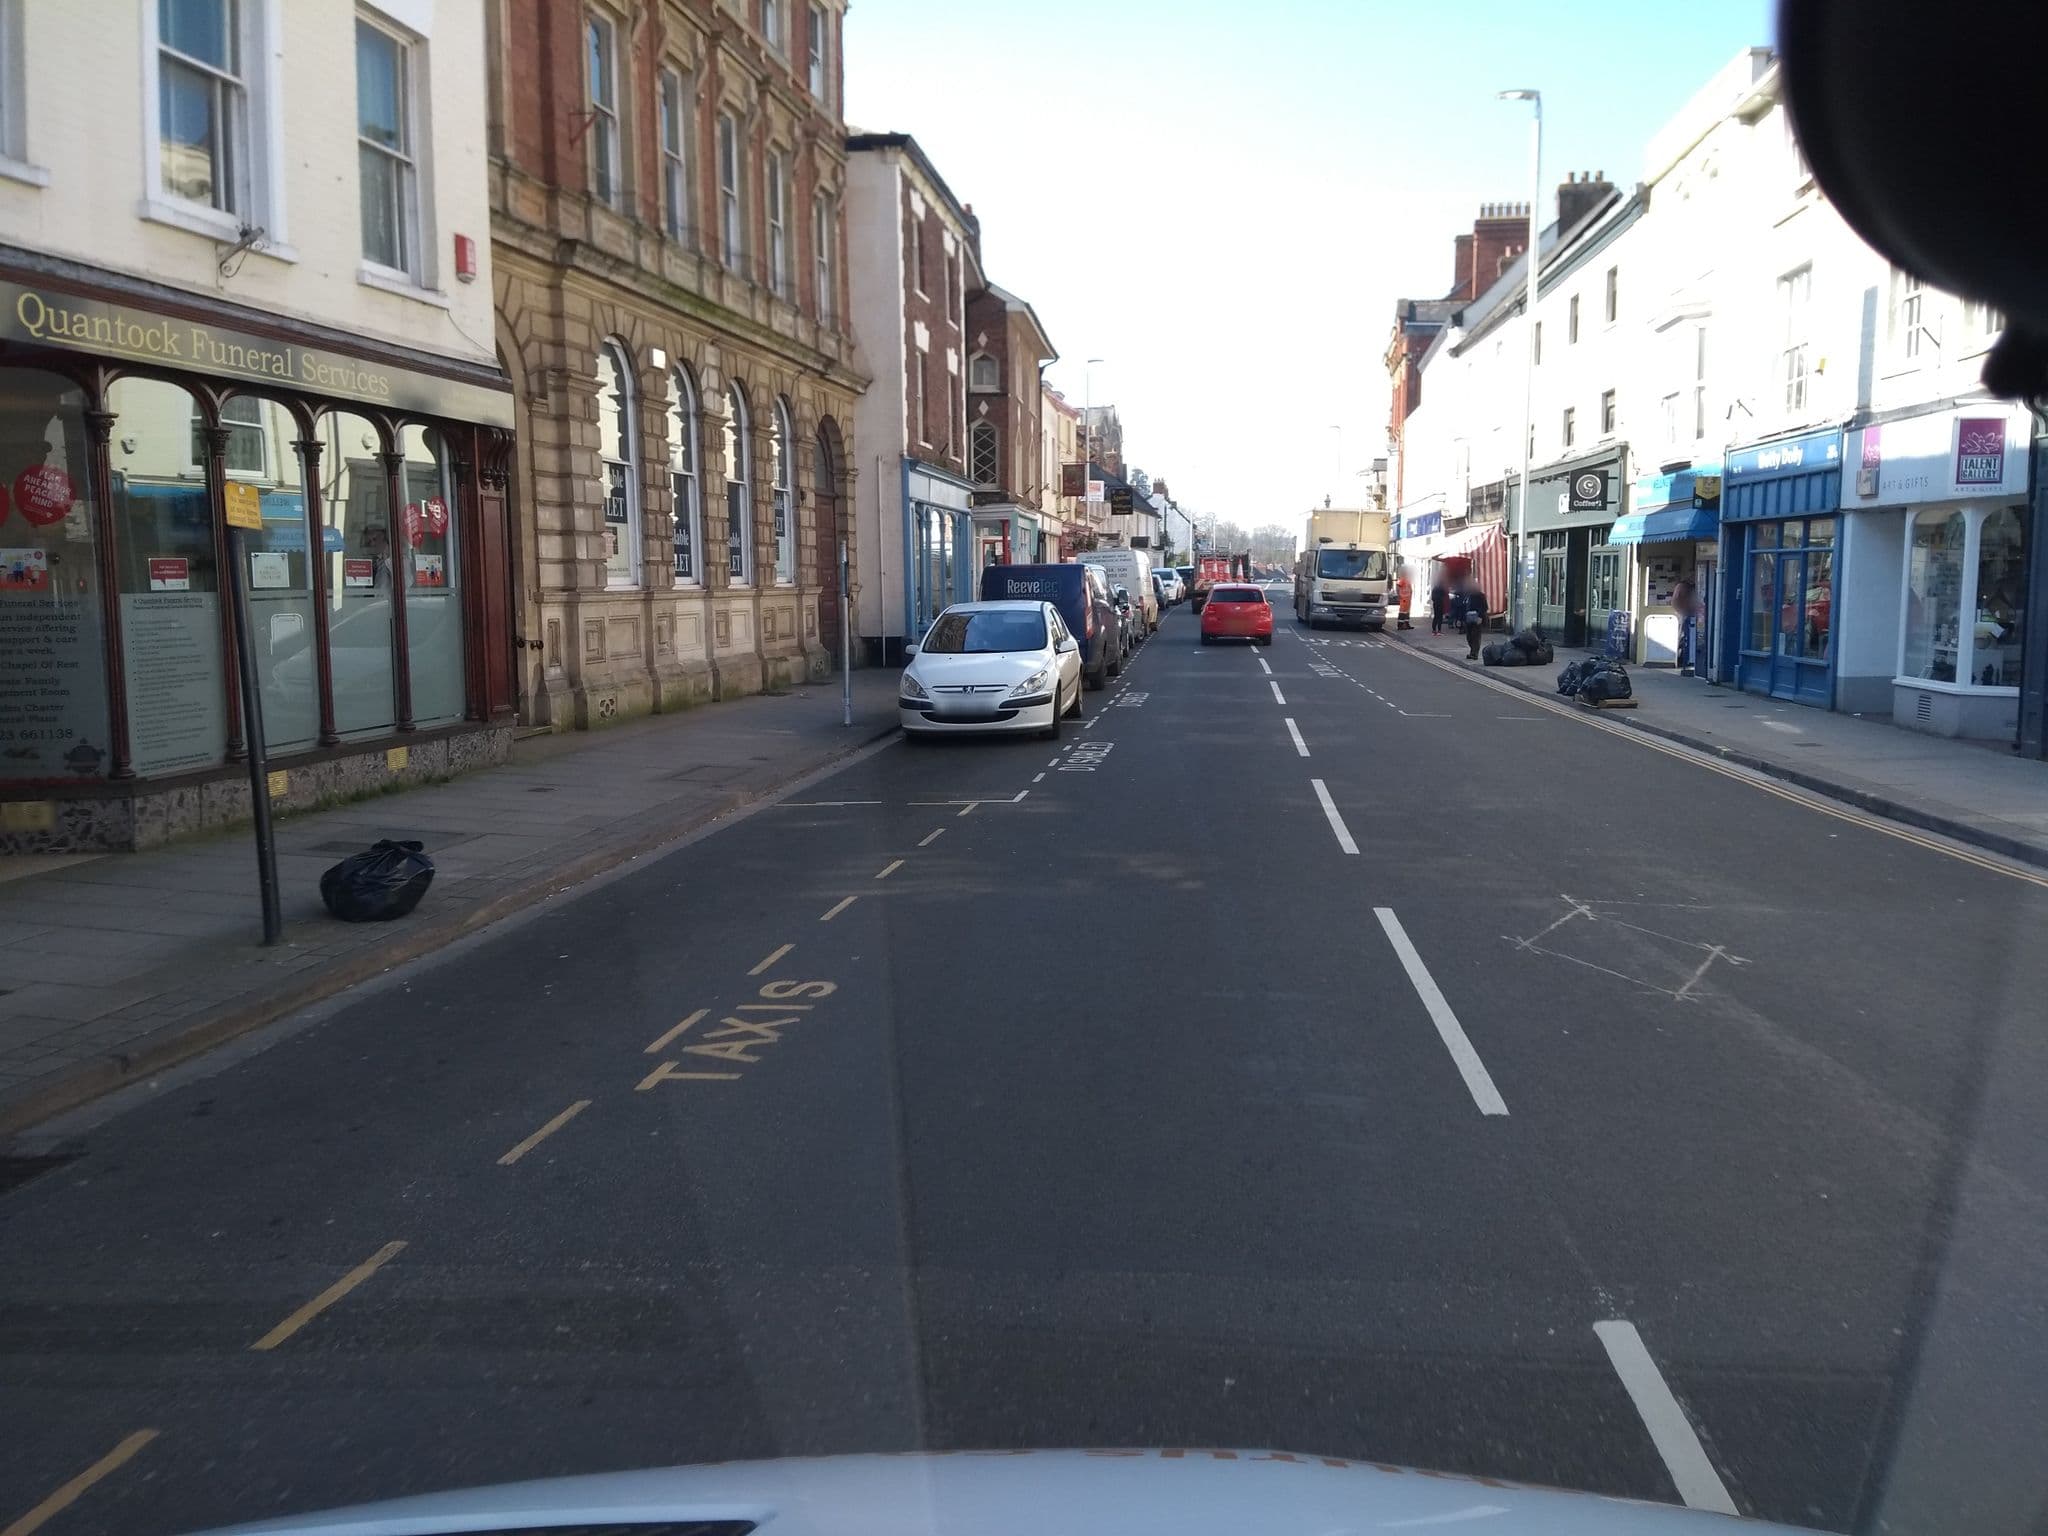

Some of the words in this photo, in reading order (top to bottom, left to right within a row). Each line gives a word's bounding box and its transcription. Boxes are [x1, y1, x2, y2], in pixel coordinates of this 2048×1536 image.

[17, 292, 182, 356] Quantock
[191, 328, 294, 377] Funeral
[302, 353, 390, 395] Services
[1964, 457, 1998, 470] TALENT
[1961, 469, 1997, 480] GALLERY
[1905, 477, 1929, 489] GIFTS
[31, 495, 54, 508] MIND
[607, 497, 624, 517] LET
[20, 728, 73, 740] 661138
[633, 980, 838, 1091] TAXIS
